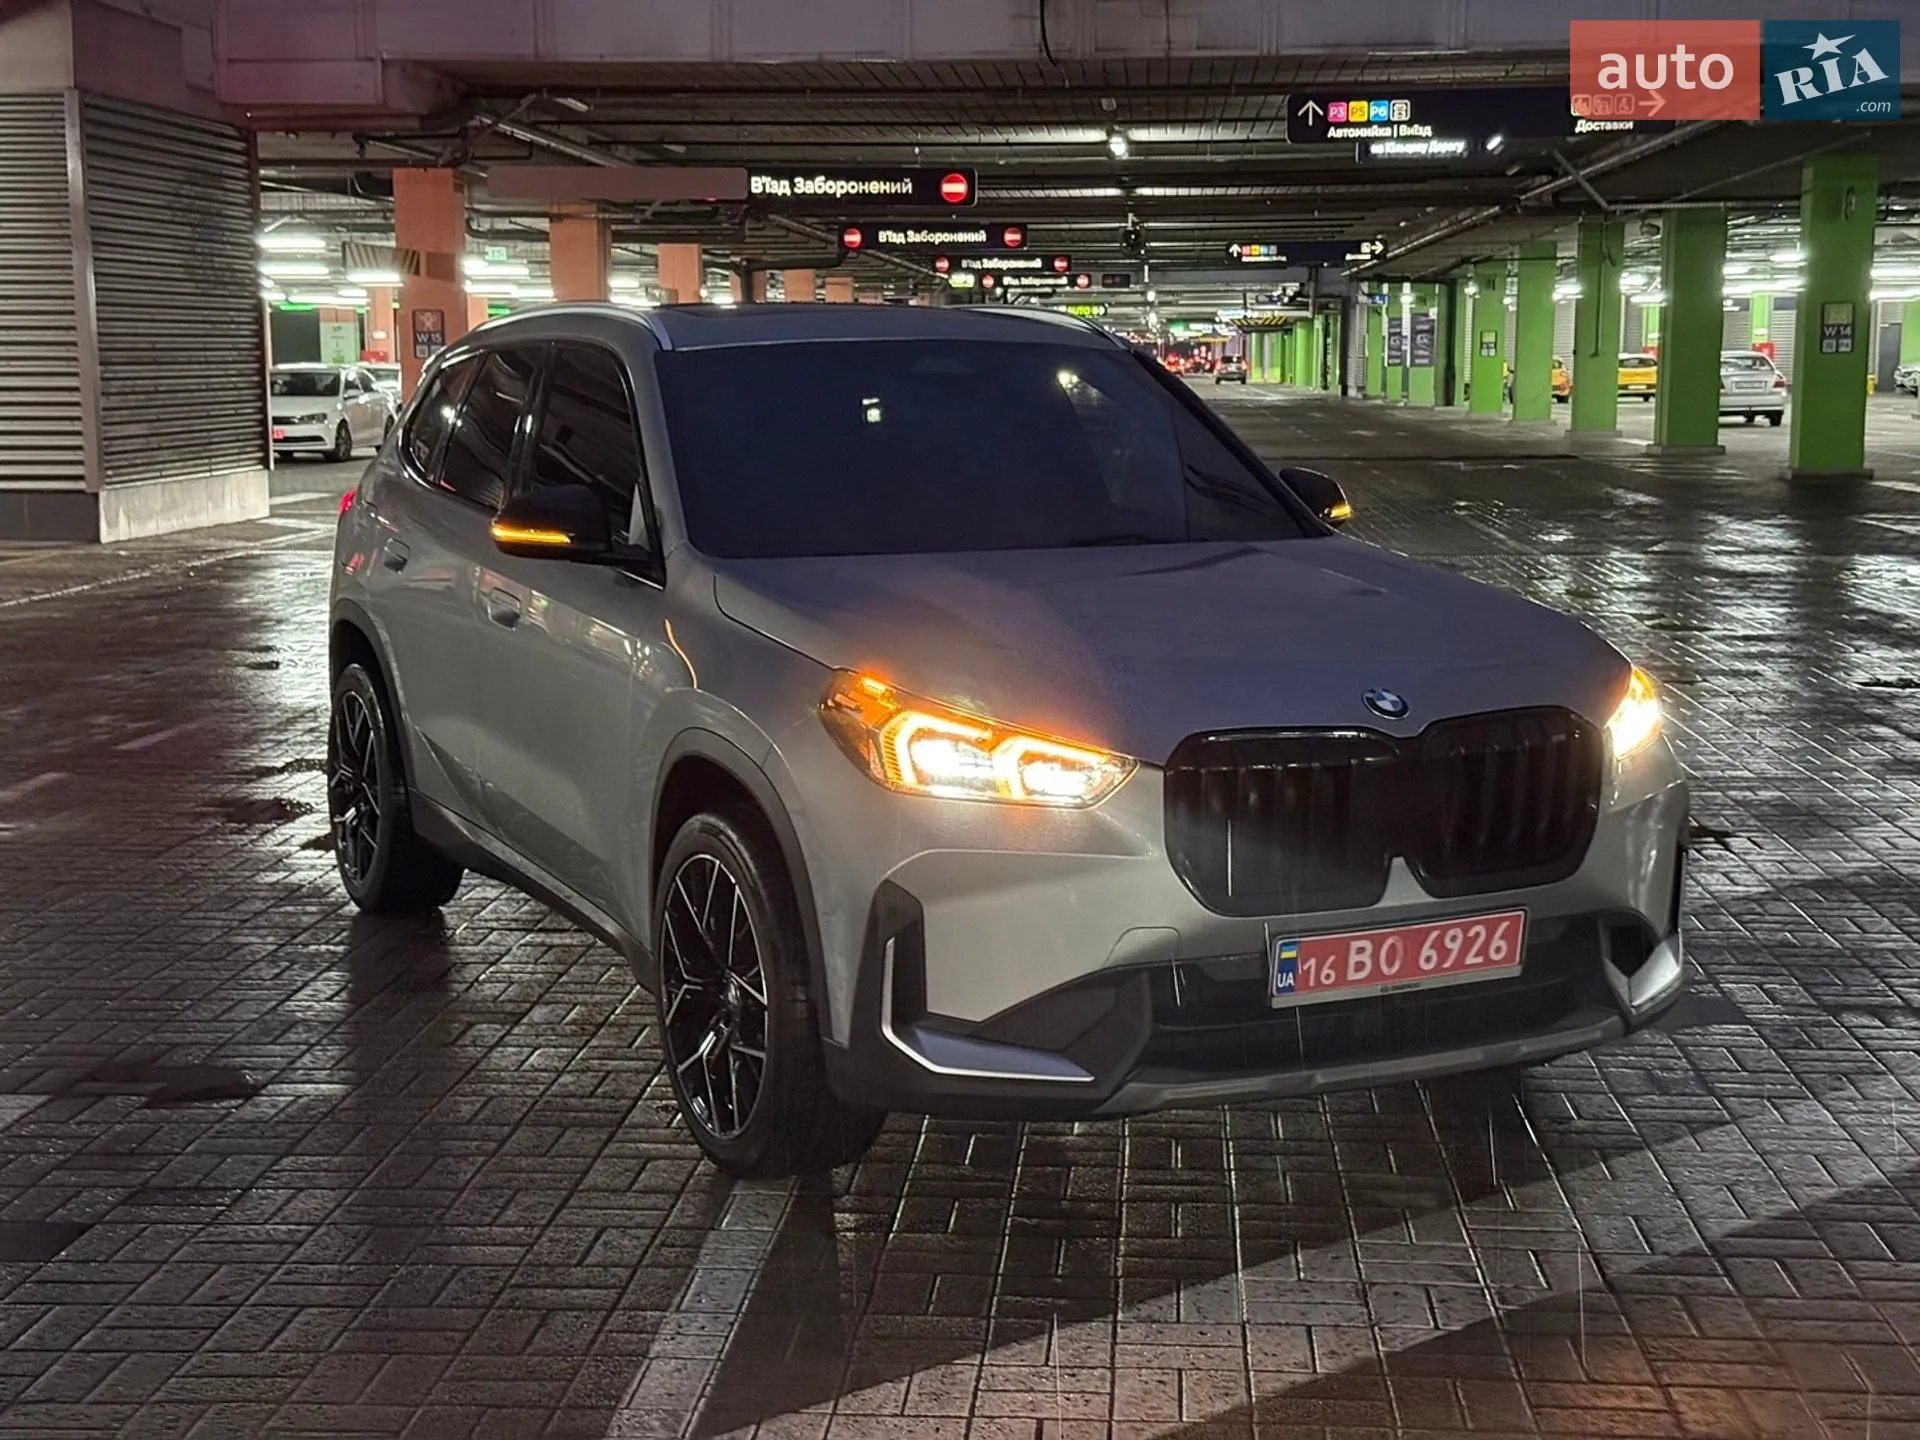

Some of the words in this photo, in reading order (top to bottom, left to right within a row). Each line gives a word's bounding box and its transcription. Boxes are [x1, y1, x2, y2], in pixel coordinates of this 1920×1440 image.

[1330, 106, 1345, 118] P3
[1351, 105, 1366, 116] P5
[1370, 104, 1386, 116] P6
[1327, 125, 1392, 138] Автомийка
[1399, 124, 1433, 138] Виїзд
[1575, 119, 1634, 133] Доставки
[794, 175, 913, 198] Заборонений
[907, 229, 987, 245] Заборонений
[416, 333, 429, 343] W
[1824, 326, 1837, 336] W
[1302, 955, 1337, 987] 16
[1419, 920, 1511, 970] 6926
[1277, 972, 1295, 988] UA
